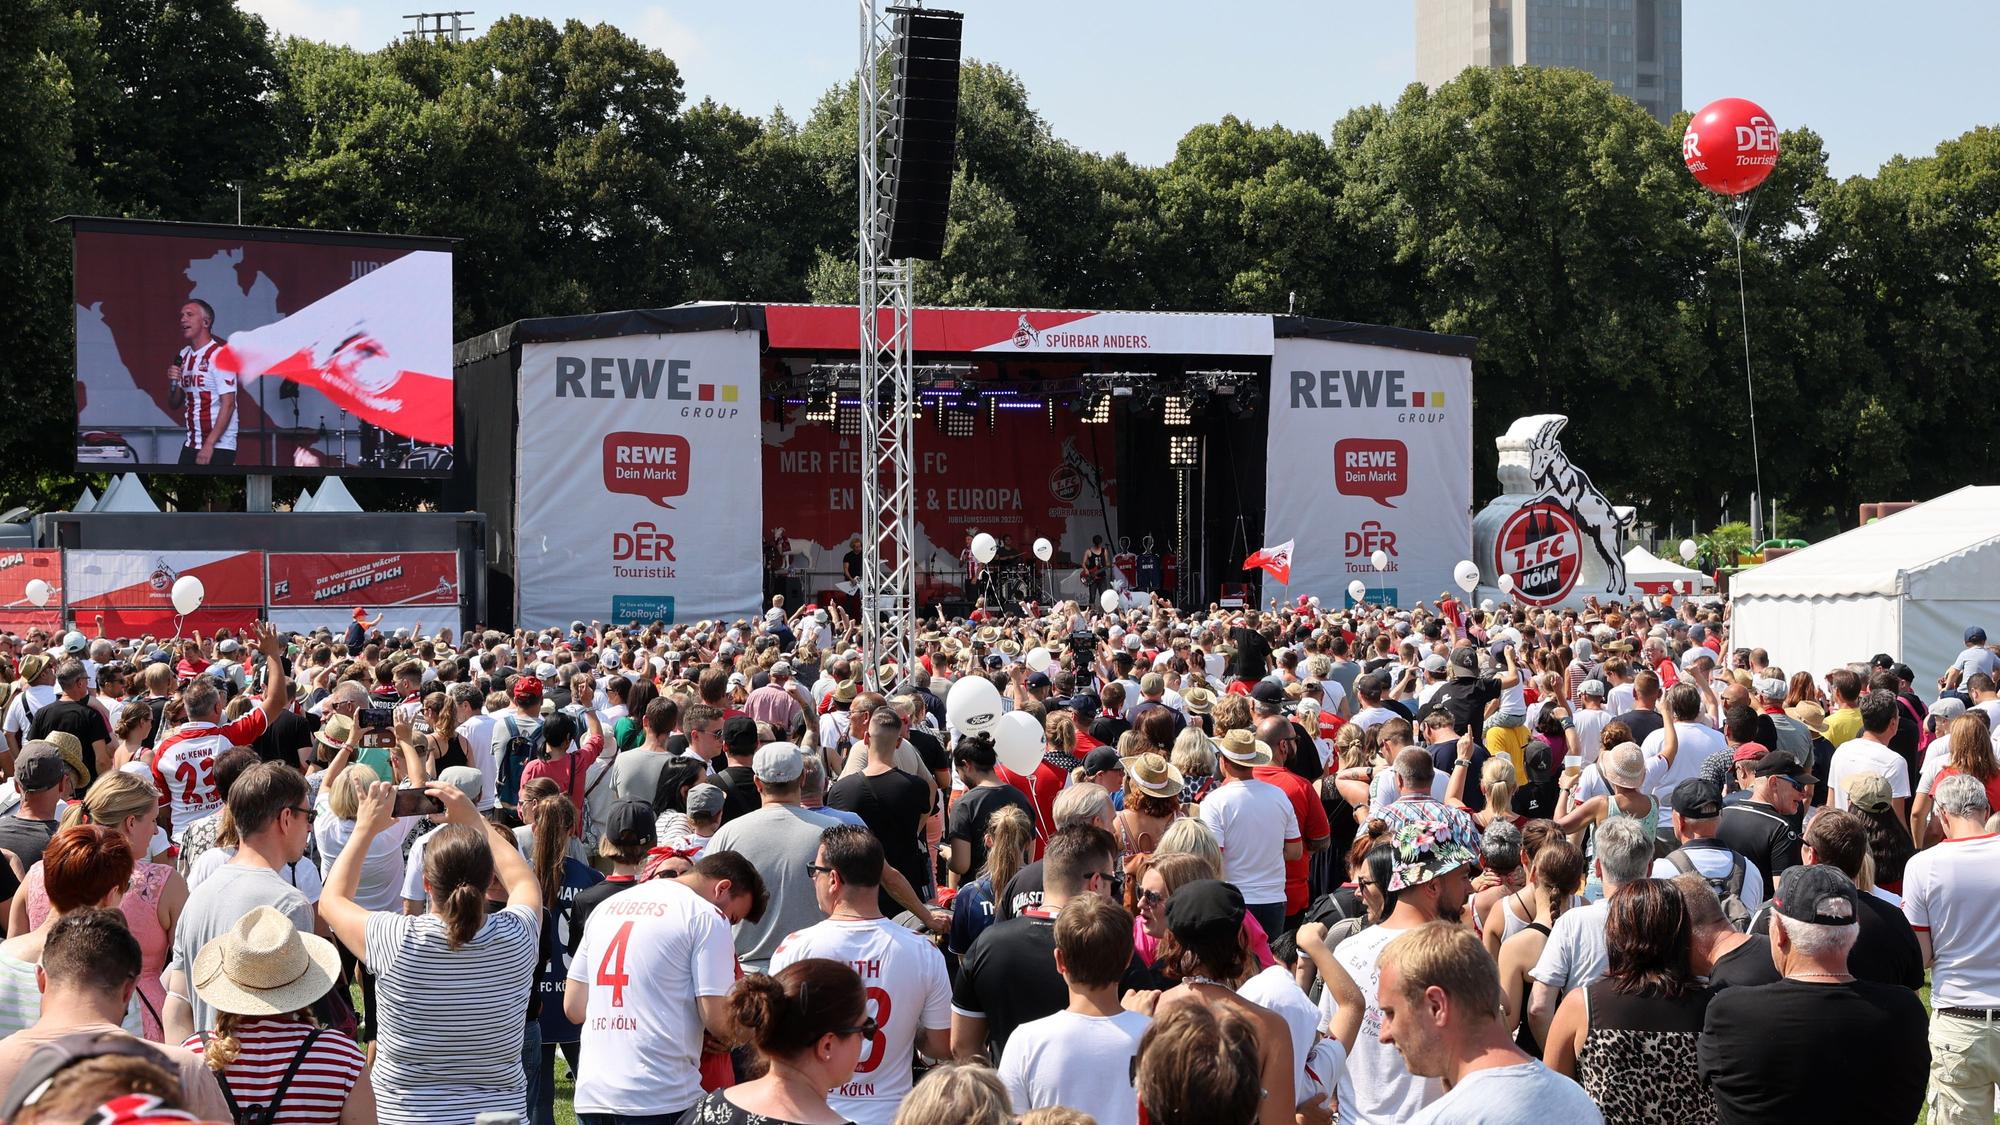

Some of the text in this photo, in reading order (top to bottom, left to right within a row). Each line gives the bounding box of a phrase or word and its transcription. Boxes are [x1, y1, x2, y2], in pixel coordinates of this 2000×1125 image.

[1735, 126, 1779, 151] DER
[1046, 332, 1099, 348] SPÜRBAR
[1103, 335, 1151, 348] ANDERS.
[555, 357, 692, 401] REWE
[1290, 370, 1407, 409] REWE
[681, 406, 738, 419] GROUP
[1398, 412, 1445, 424] GROUP
[616, 446, 677, 465] REWE
[780, 452, 822, 473] MER
[924, 452, 948, 474] FC
[1345, 451, 1397, 468] REWE
[616, 467, 677, 480] Dein Markt
[1345, 470, 1397, 482] Dein Markt
[830, 488, 854, 510] EN
[926, 488, 940, 511] &
[947, 488, 1023, 511] EUROPA
[613, 532, 677, 562] DER
[1345, 532, 1399, 557] DER
[1514, 536, 1565, 570] 1.FC
[316, 555, 401, 585] DIE VORFREUDE WÄCHST
[613, 566, 677, 579] Touristik
[1522, 565, 1559, 590] KÖLN
[274, 583, 288, 596] FC
[314, 566, 402, 600] AUCH AUF DICH
[619, 608, 664, 620] ZooRoyal
[971, 715, 990, 725] Ford
[188, 747, 213, 759] KENNA
[605, 899, 668, 918] HÜBERS
[596, 920, 636, 1007] 4
[610, 1014, 637, 1030] KÖLN
[840, 1082, 874, 1096] KÖLN
